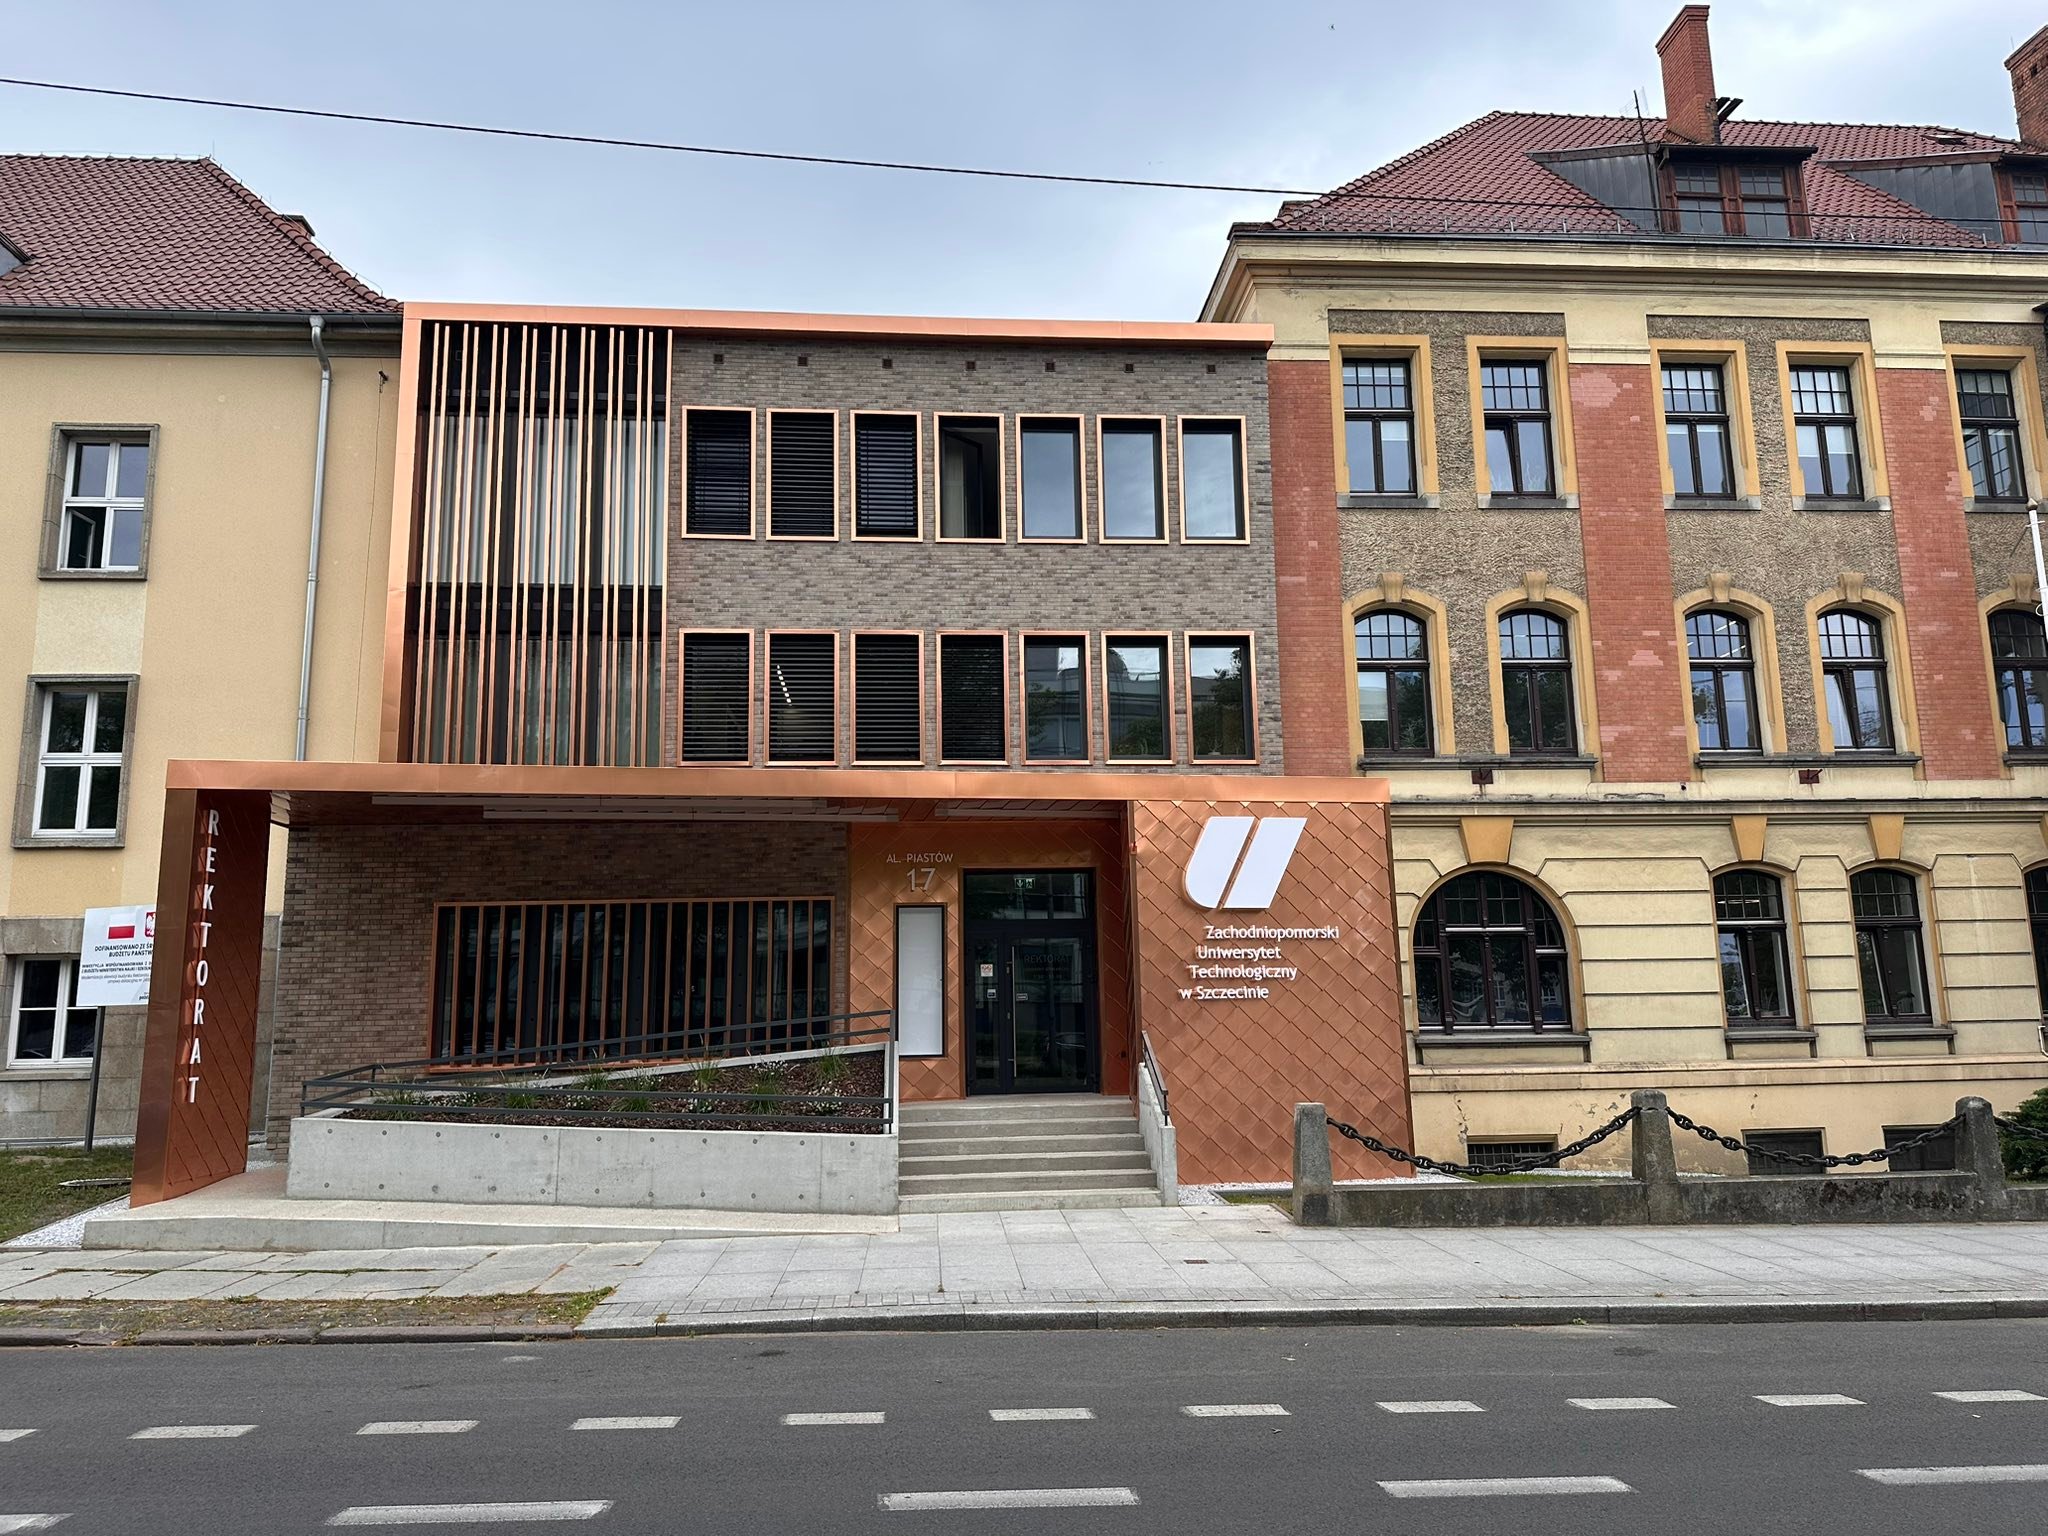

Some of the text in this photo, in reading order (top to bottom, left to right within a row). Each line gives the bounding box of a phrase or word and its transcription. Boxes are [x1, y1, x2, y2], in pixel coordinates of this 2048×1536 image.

[886, 851, 954, 863] AL. PIASTÓW
[906, 867, 936, 892] 17
[1205, 925, 1340, 942] Zachodniopomorski
[188, 808, 219, 1103] REKTORAT
[1196, 945, 1282, 962] Uniwersytet
[1188, 965, 1297, 980] Technologiczny
[1179, 985, 1270, 999] w Szczecinie
